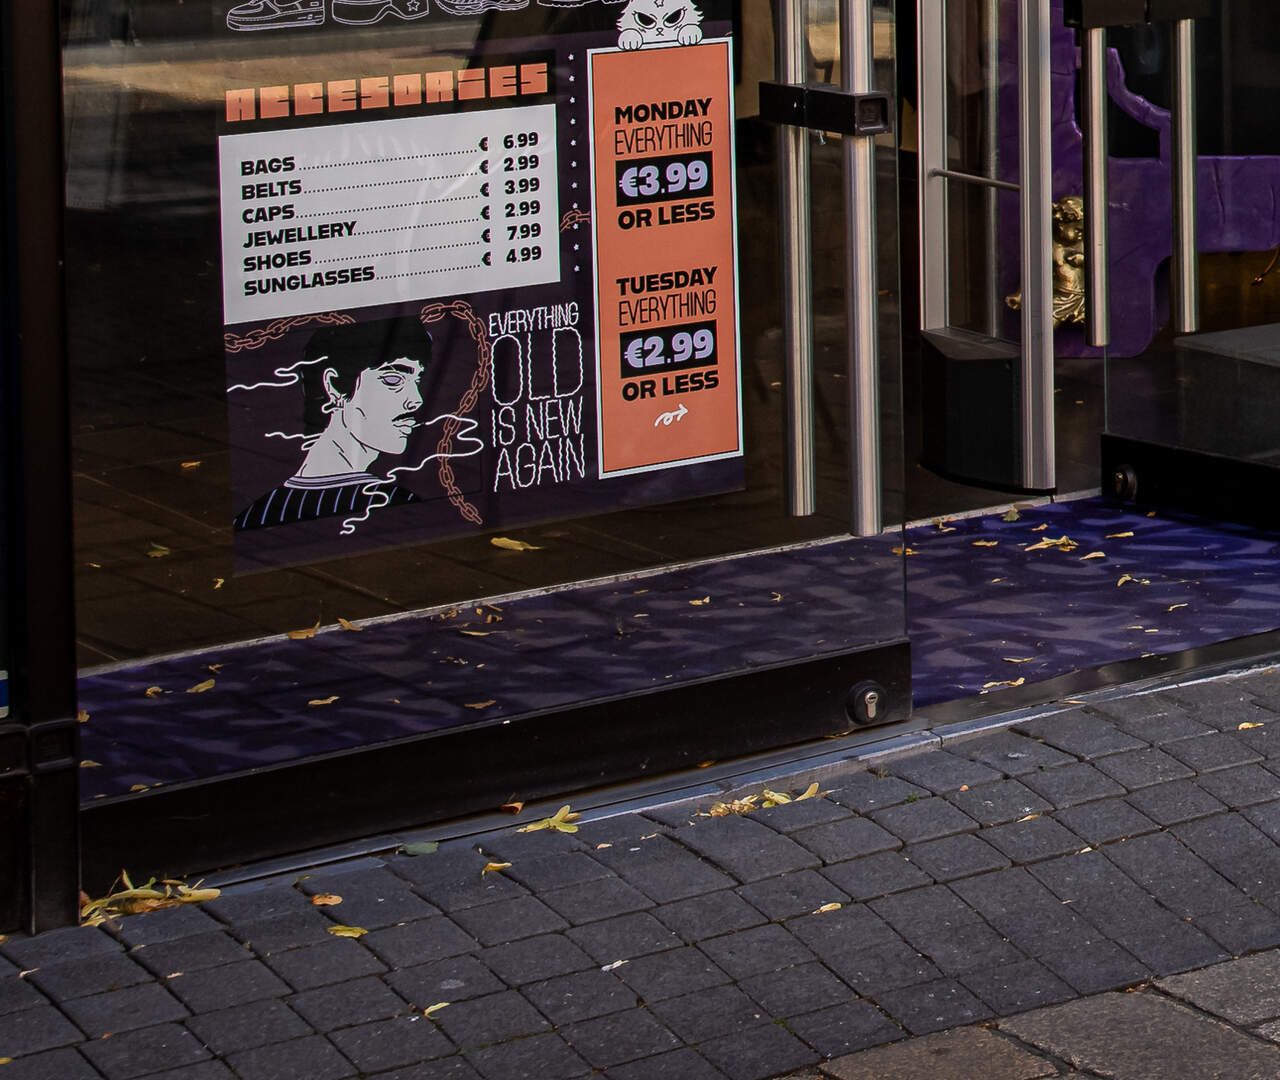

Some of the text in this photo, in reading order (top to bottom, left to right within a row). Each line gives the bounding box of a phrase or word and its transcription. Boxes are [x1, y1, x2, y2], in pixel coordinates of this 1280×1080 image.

[615, 98, 712, 124] MONDAY
[240, 156, 296, 176] BAGS
[503, 131, 539, 149] 6.99
[615, 121, 712, 155] EVERYTHING
[241, 179, 302, 200] BELTS
[504, 154, 539, 172] 2.99
[619, 160, 708, 197] €3.99
[242, 204, 295, 224] CAPS
[504, 177, 540, 194] 3.99
[618, 201, 715, 230] OR LESS
[243, 221, 357, 248] JEWELLERY
[504, 200, 541, 217] 2.99
[243, 250, 311, 272] SHOES
[507, 222, 542, 240] 7.99
[244, 266, 375, 296] SUNGLASSES
[506, 245, 542, 263] 4.99
[616, 266, 717, 296] TUESDAY
[489, 302, 579, 337] EVERYTHING
[619, 289, 716, 326] EVERYTHING
[491, 326, 583, 406] OLD
[624, 329, 714, 368] €2.99
[622, 370, 719, 401] OR LESS
[492, 395, 583, 447] IS NEW
[494, 434, 585, 492] AGAIN
